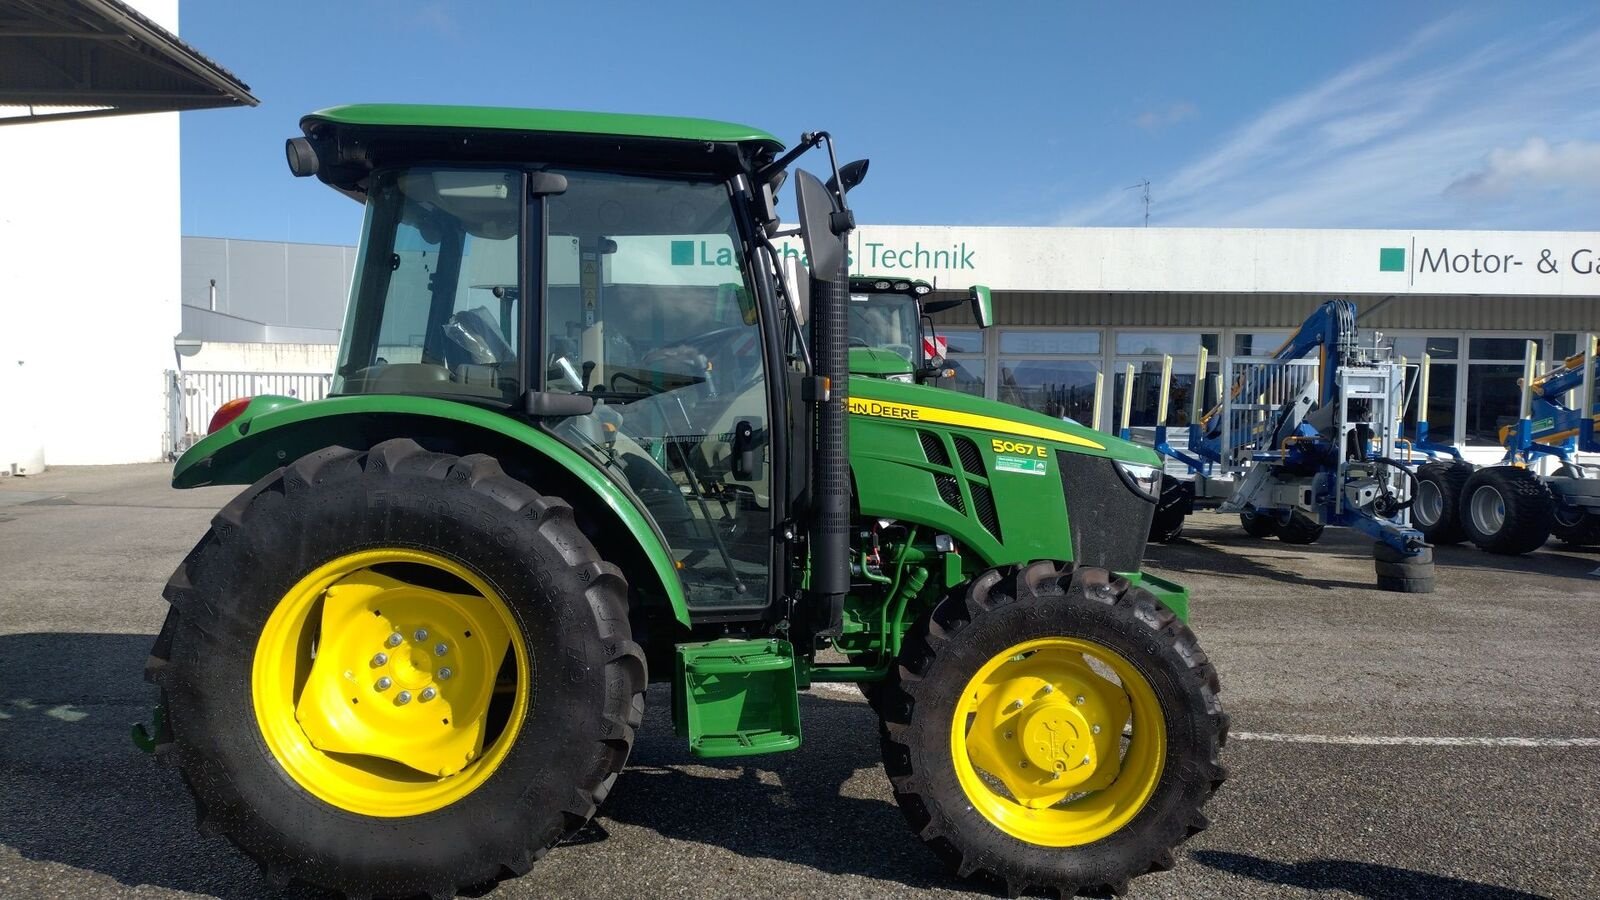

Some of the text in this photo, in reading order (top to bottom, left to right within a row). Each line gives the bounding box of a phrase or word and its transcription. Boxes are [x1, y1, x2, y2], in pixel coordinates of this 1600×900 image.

[865, 242, 975, 269] Technik
[1419, 248, 1523, 273] Motor-
[1537, 249, 1559, 274] &
[841, 401, 919, 419] OHN DEERE
[991, 439, 1048, 458] 5067 E
